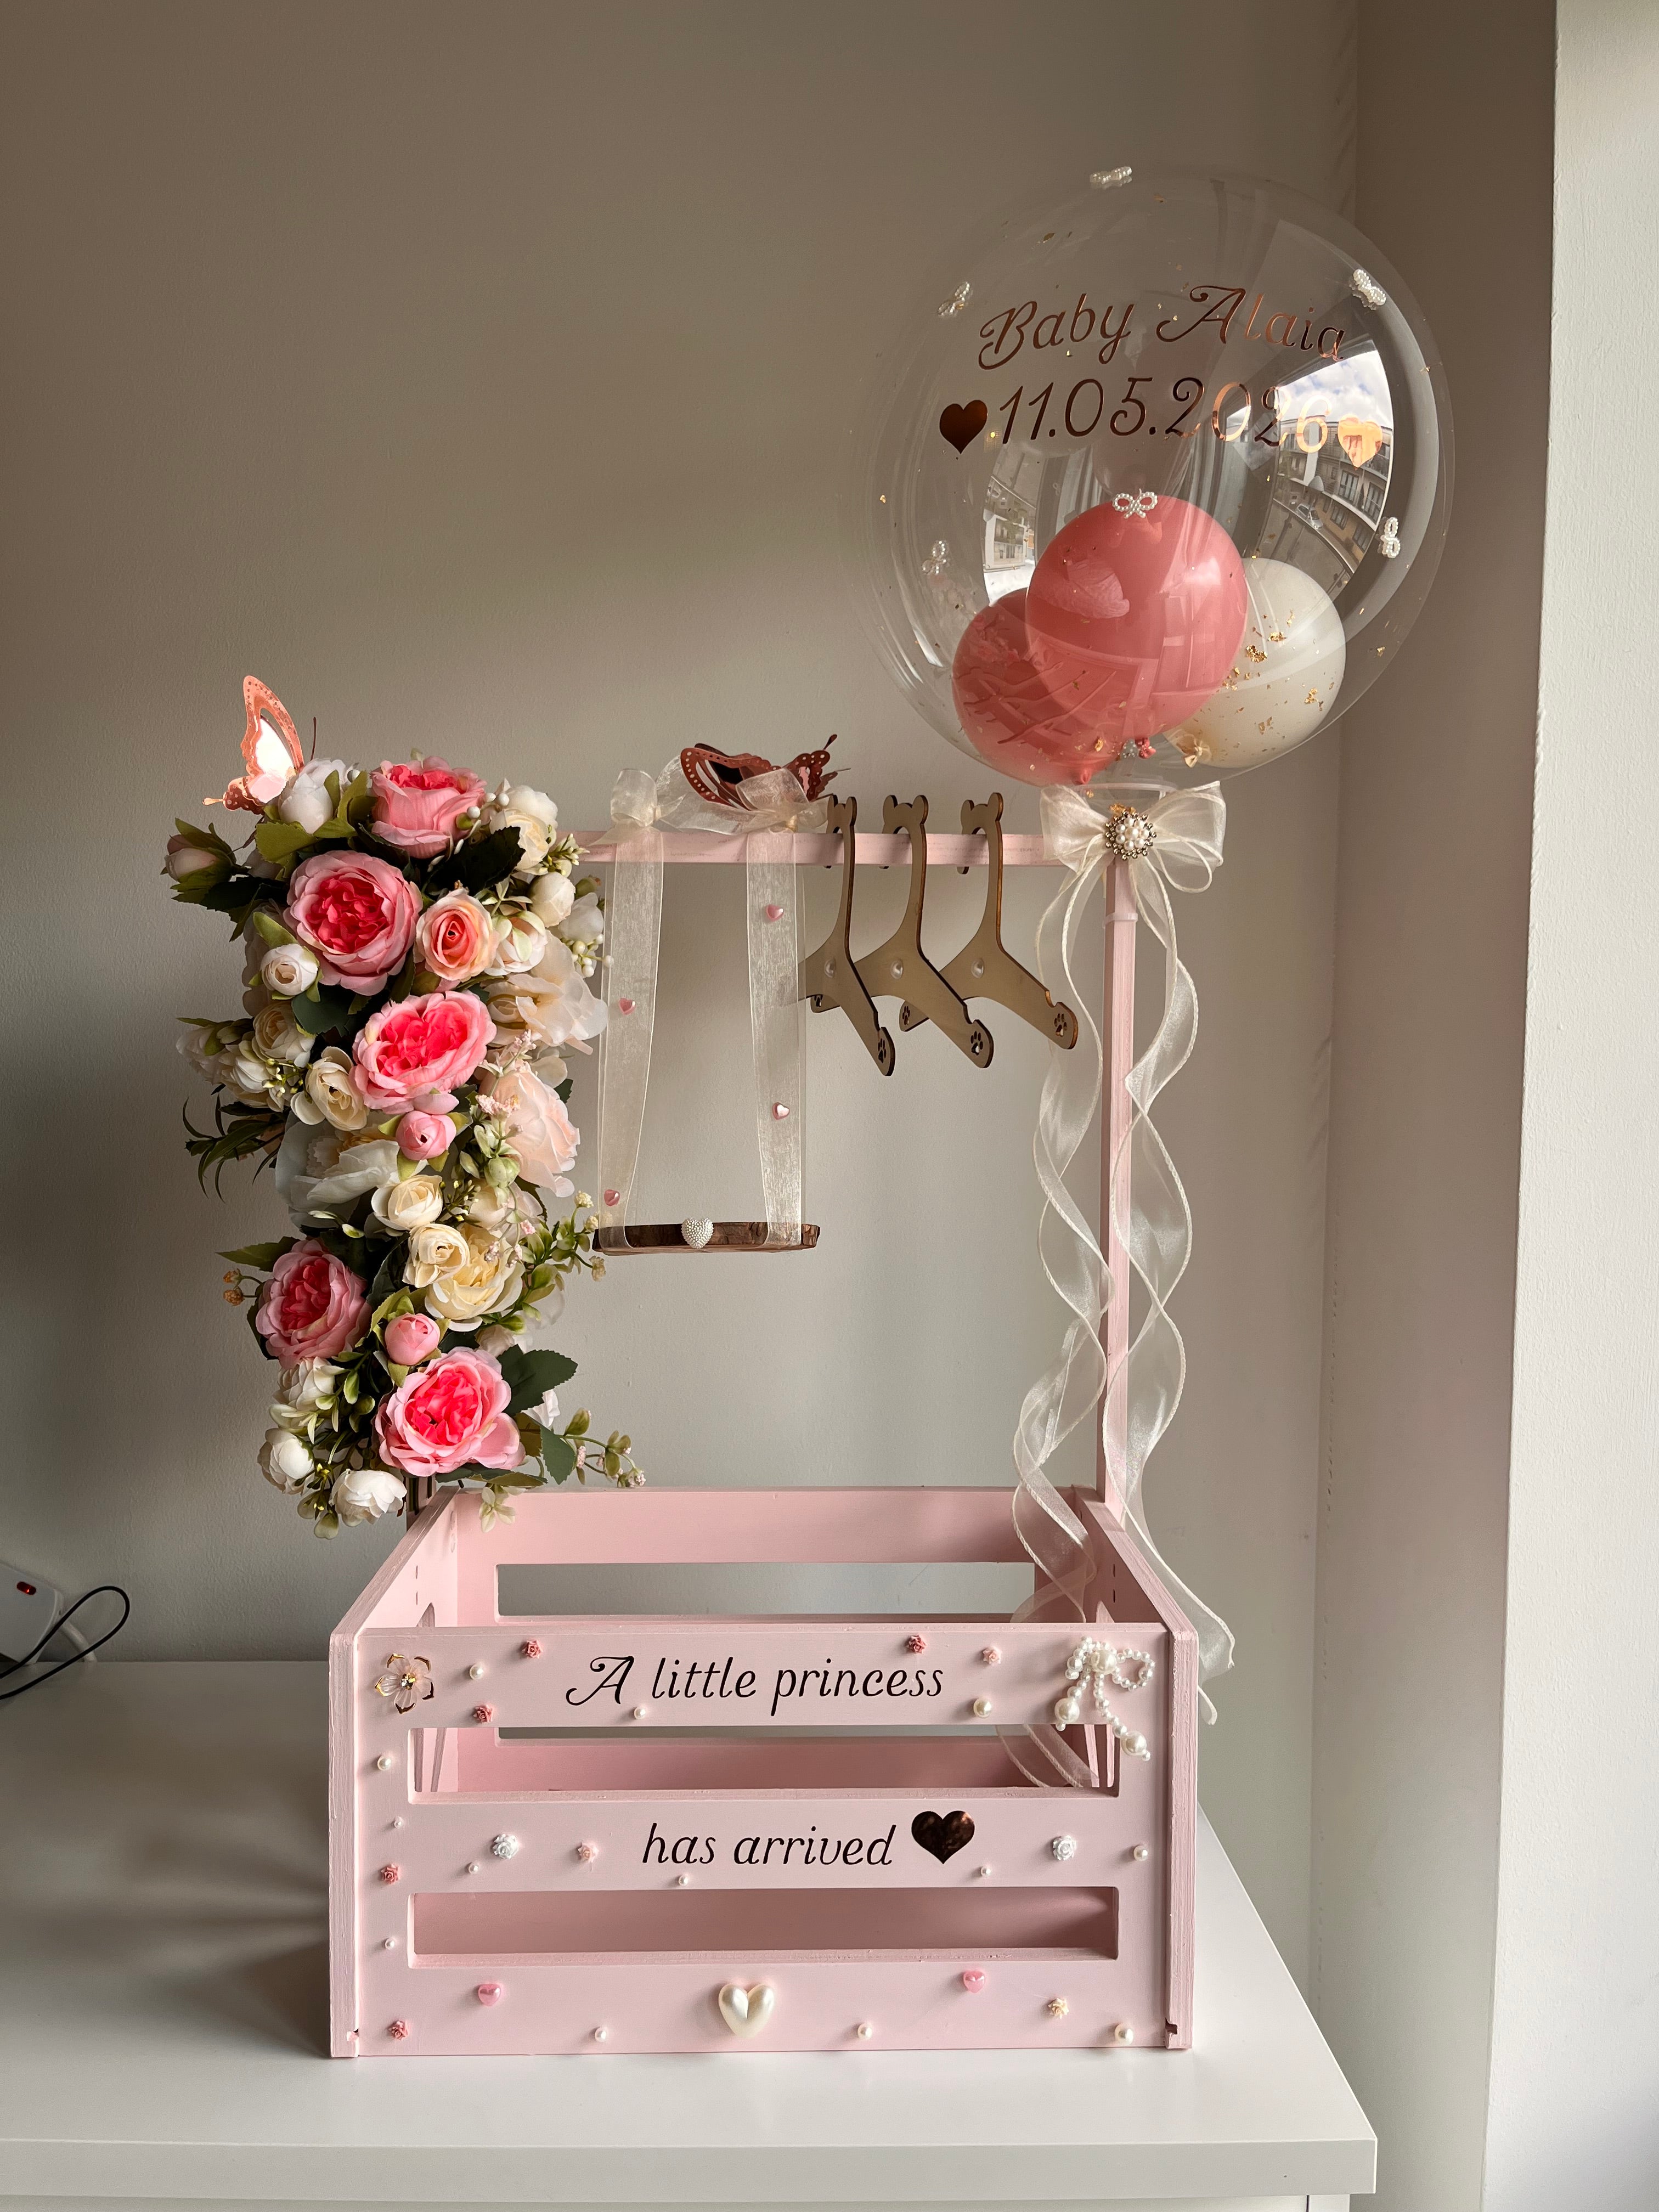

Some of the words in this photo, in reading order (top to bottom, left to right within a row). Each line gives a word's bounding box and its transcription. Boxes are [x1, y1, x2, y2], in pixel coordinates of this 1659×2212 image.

[978, 293, 1135, 370] Baby
[1156, 285, 1346, 362] Alaia
[1000, 376, 1333, 454] 11.05.2026
[566, 1656, 635, 1706] A
[652, 1656, 757, 1699] little
[770, 1658, 944, 1717] princess
[642, 1822, 716, 1864] has
[733, 1824, 897, 1866] arrived
